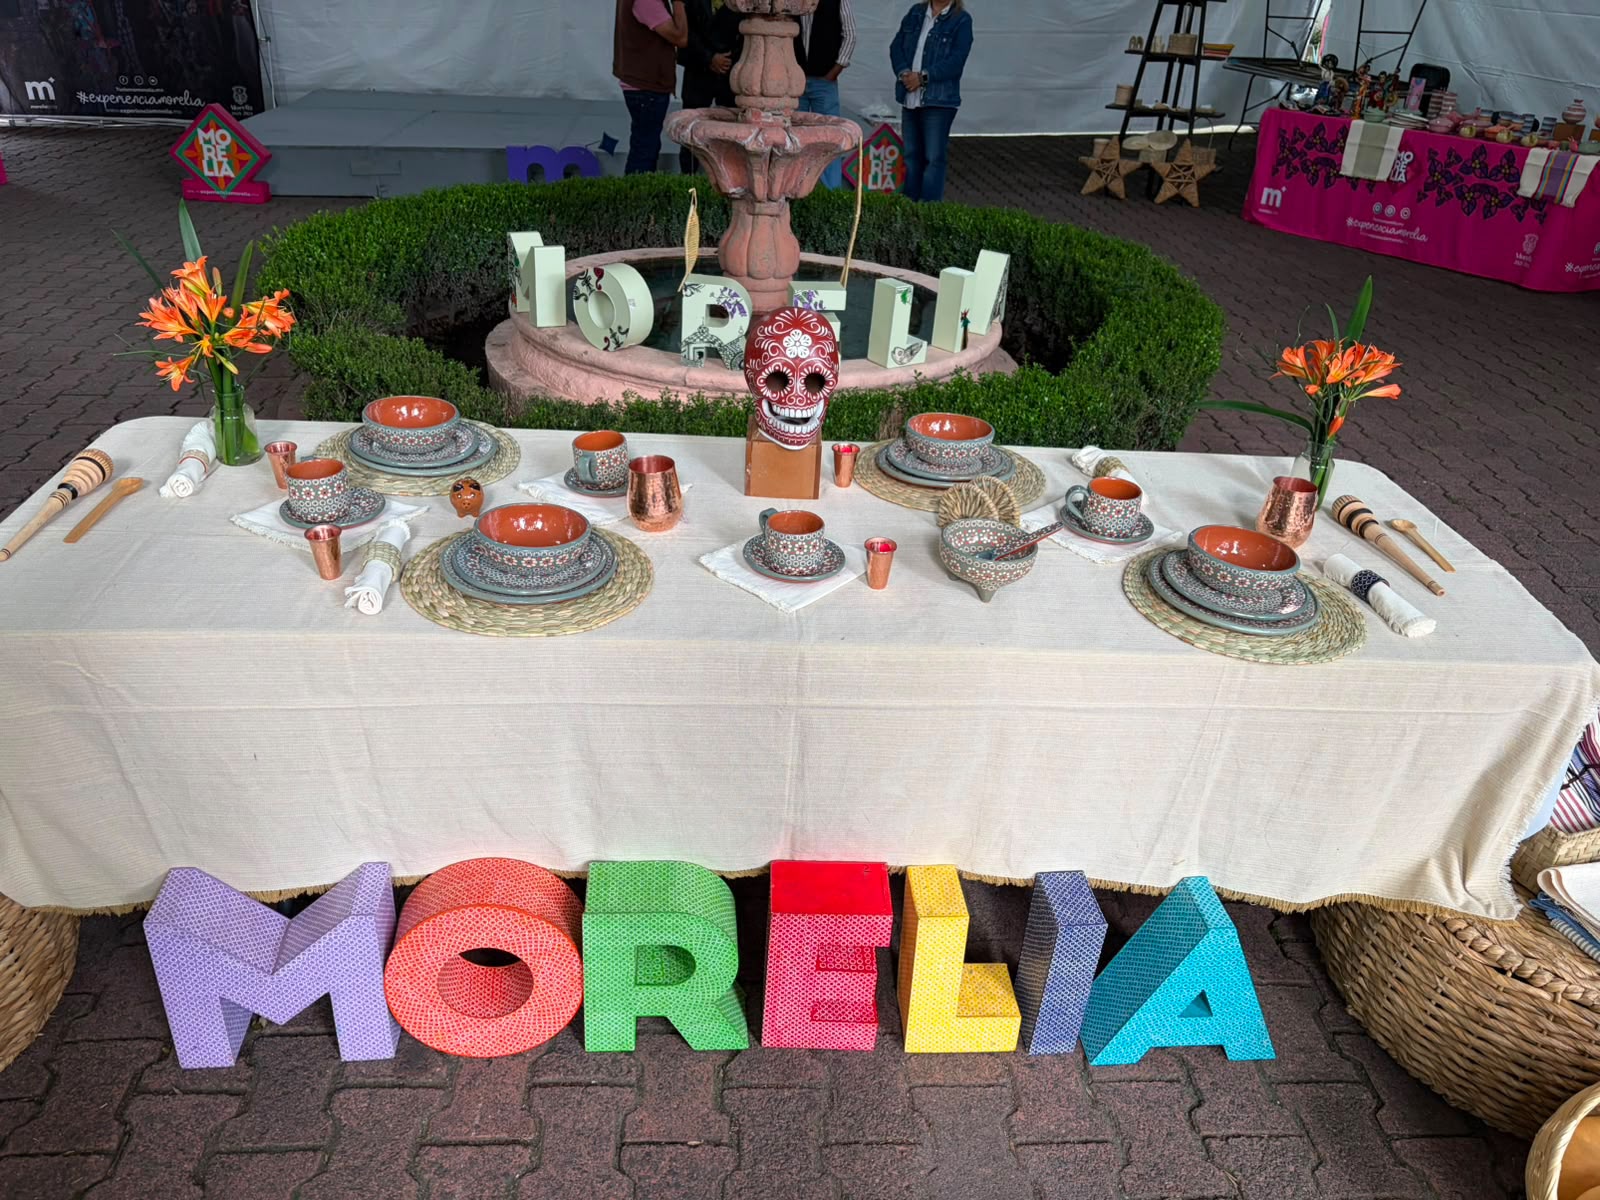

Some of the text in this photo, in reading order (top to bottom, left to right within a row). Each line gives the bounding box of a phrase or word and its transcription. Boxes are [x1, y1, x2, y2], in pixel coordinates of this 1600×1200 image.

[197, 127, 232, 146] MO
[202, 143, 228, 161] RE
[869, 144, 899, 161] MO
[202, 159, 236, 178] LIA
[870, 159, 895, 175] RE
[868, 174, 896, 190] LIA
[143, 857, 1276, 1069] MORELIA
